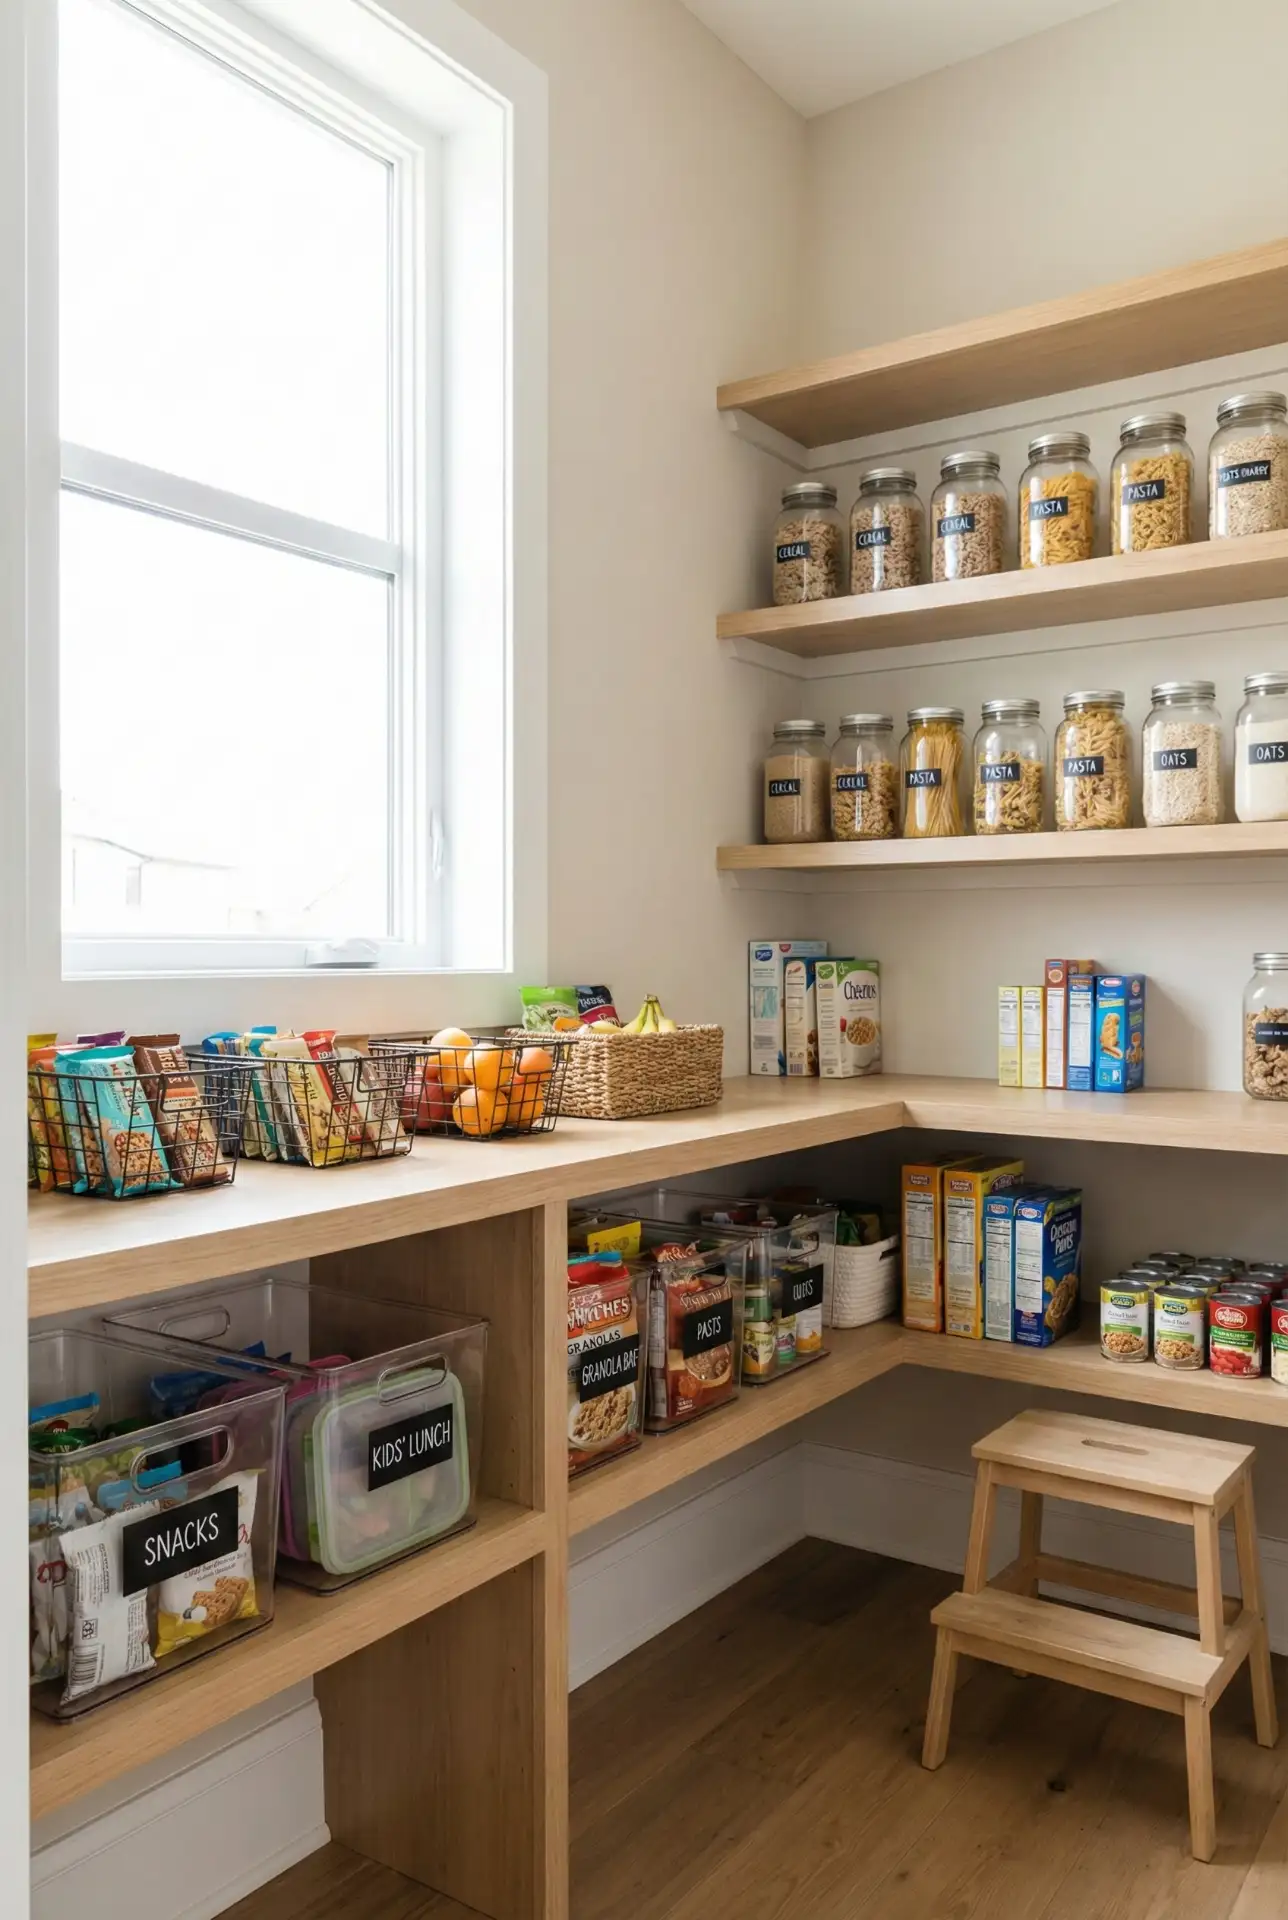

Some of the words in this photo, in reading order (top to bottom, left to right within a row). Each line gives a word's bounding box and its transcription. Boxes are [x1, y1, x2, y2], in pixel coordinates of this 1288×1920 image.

[1128, 484, 1158, 499] PASTA
[1033, 500, 1063, 515] PASTA
[1257, 745, 1285, 760] OATS
[986, 766, 1013, 779] PASTA
[1067, 759, 1096, 773] PASTA
[909, 771, 936, 785] PASTA
[697, 1315, 721, 1341] PASTS
[568, 1330, 621, 1355] GRANOLAS
[582, 1354, 622, 1386] GRANOLA
[372, 1435, 406, 1472] KIDS'
[409, 1419, 451, 1458] LUNCH
[144, 1512, 219, 1567] SNACKS
